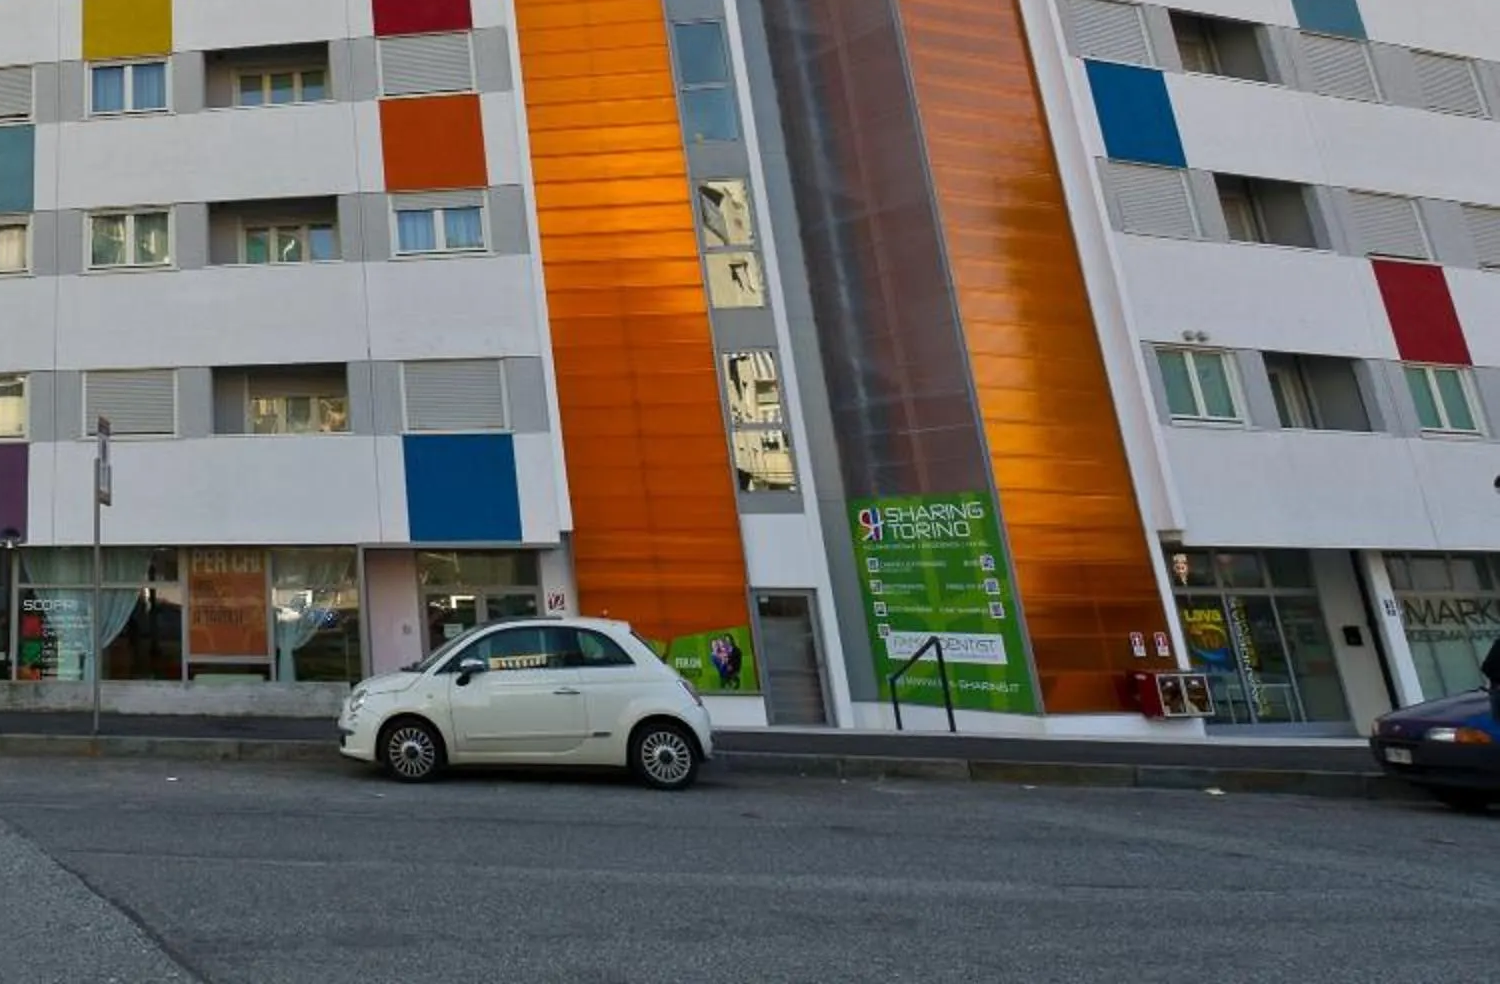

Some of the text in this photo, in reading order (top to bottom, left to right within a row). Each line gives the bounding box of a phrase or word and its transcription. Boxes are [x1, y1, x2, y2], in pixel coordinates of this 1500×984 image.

[884, 501, 984, 523] SHARING
[887, 521, 971, 539] TORINO
[193, 550, 261, 573] PER CHI
[1403, 599, 1500, 627] MARK
